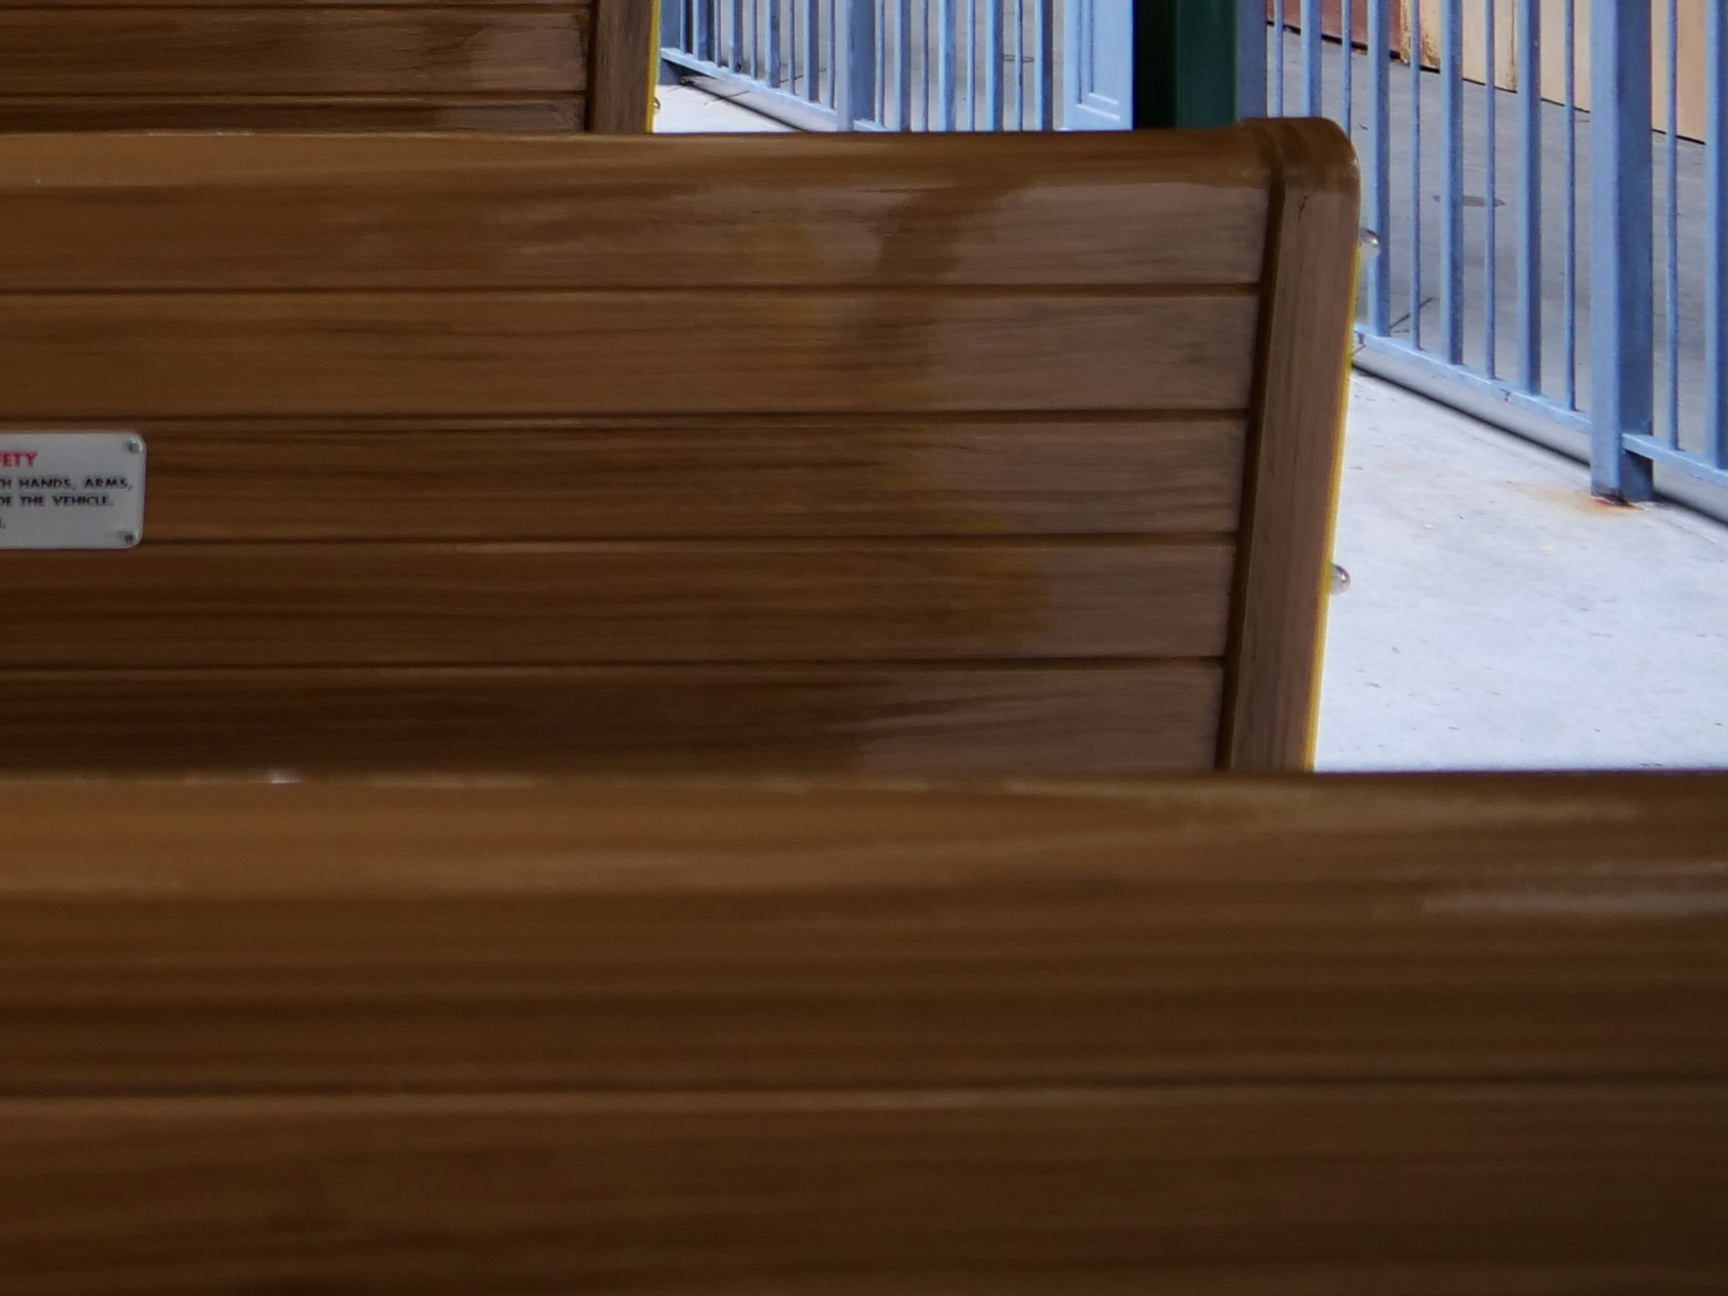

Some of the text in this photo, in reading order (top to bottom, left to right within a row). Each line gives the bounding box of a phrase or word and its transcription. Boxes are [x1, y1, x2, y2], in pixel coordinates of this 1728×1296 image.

[19, 477, 76, 491] HANDS,
[84, 477, 132, 491] ARMS,
[20, 495, 44, 507] THE
